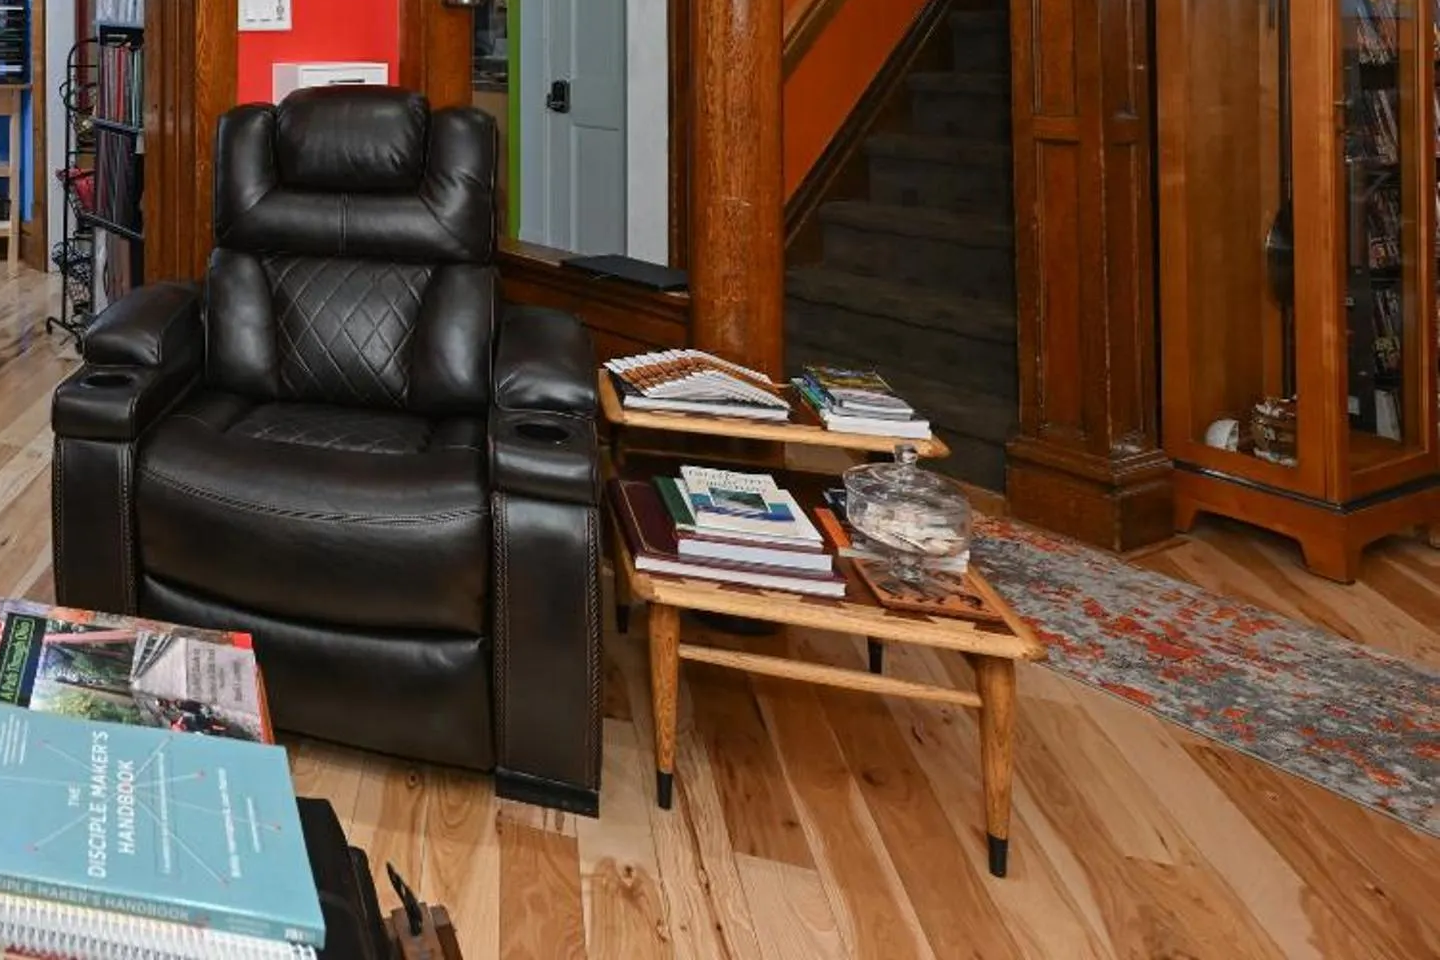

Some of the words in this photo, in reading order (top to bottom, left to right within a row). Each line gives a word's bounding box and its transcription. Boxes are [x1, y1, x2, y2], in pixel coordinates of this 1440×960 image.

[68, 782, 81, 807] THE
[89, 730, 109, 798] MAKER'S
[87, 802, 108, 879] DISCIPLE
[116, 759, 136, 855] HANDBOOK
